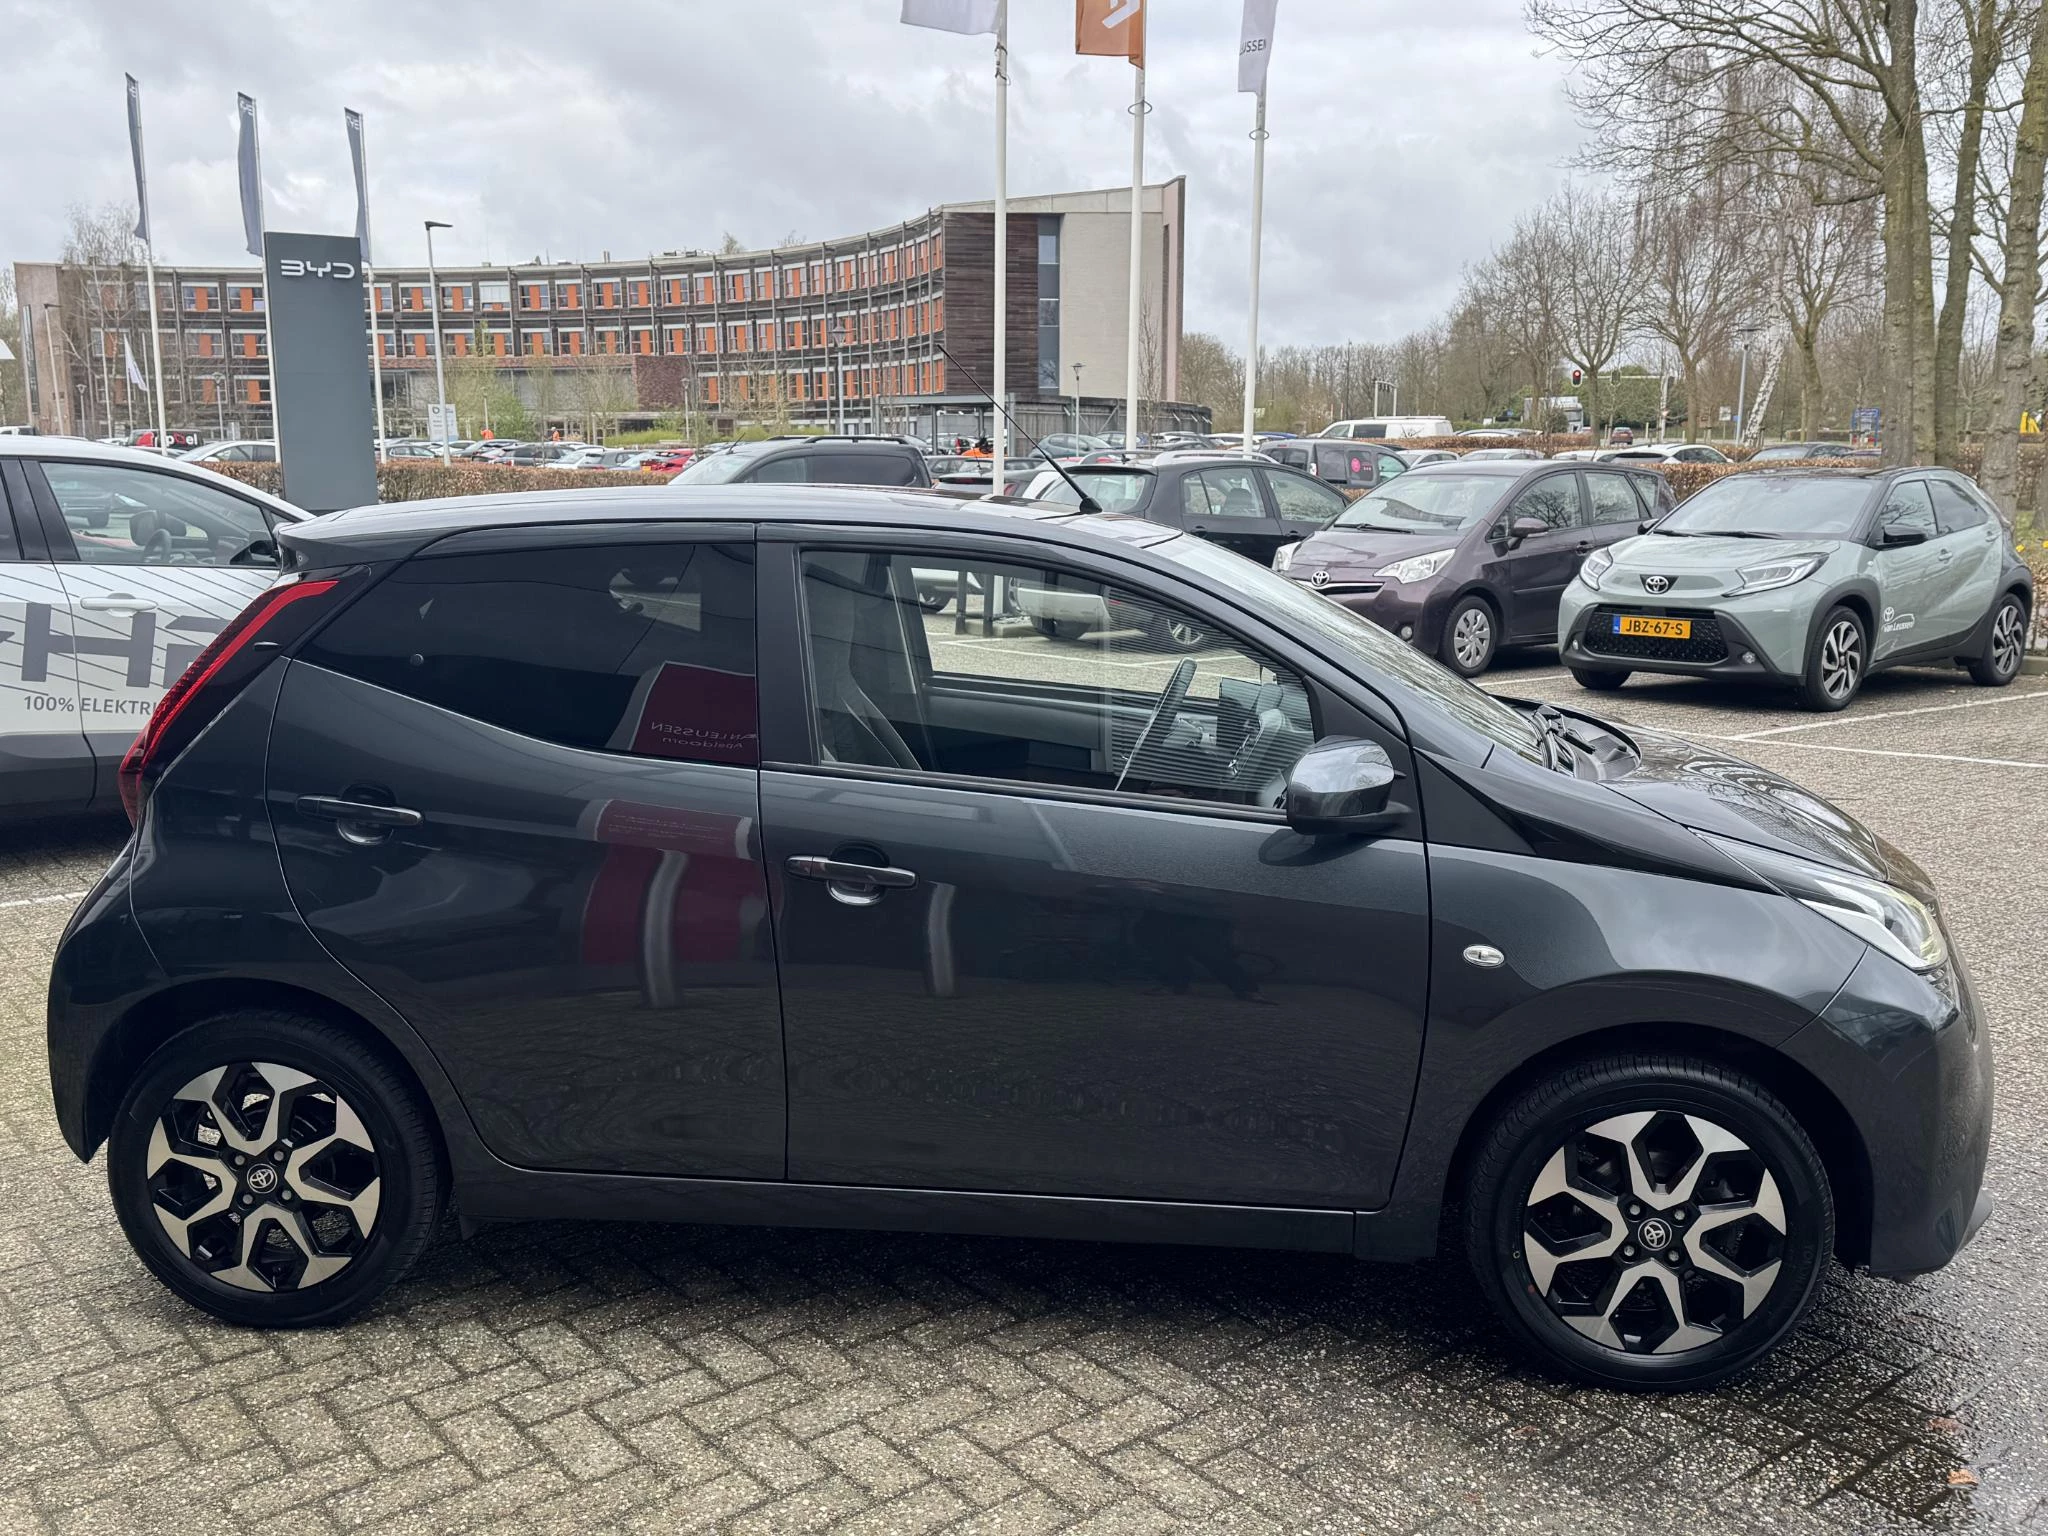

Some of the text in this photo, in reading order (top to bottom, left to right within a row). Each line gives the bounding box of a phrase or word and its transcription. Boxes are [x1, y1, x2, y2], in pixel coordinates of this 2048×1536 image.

[280, 259, 355, 279] BYD
[1625, 619, 1683, 635] JBZ-67-S
[24, 695, 75, 712] 100%
